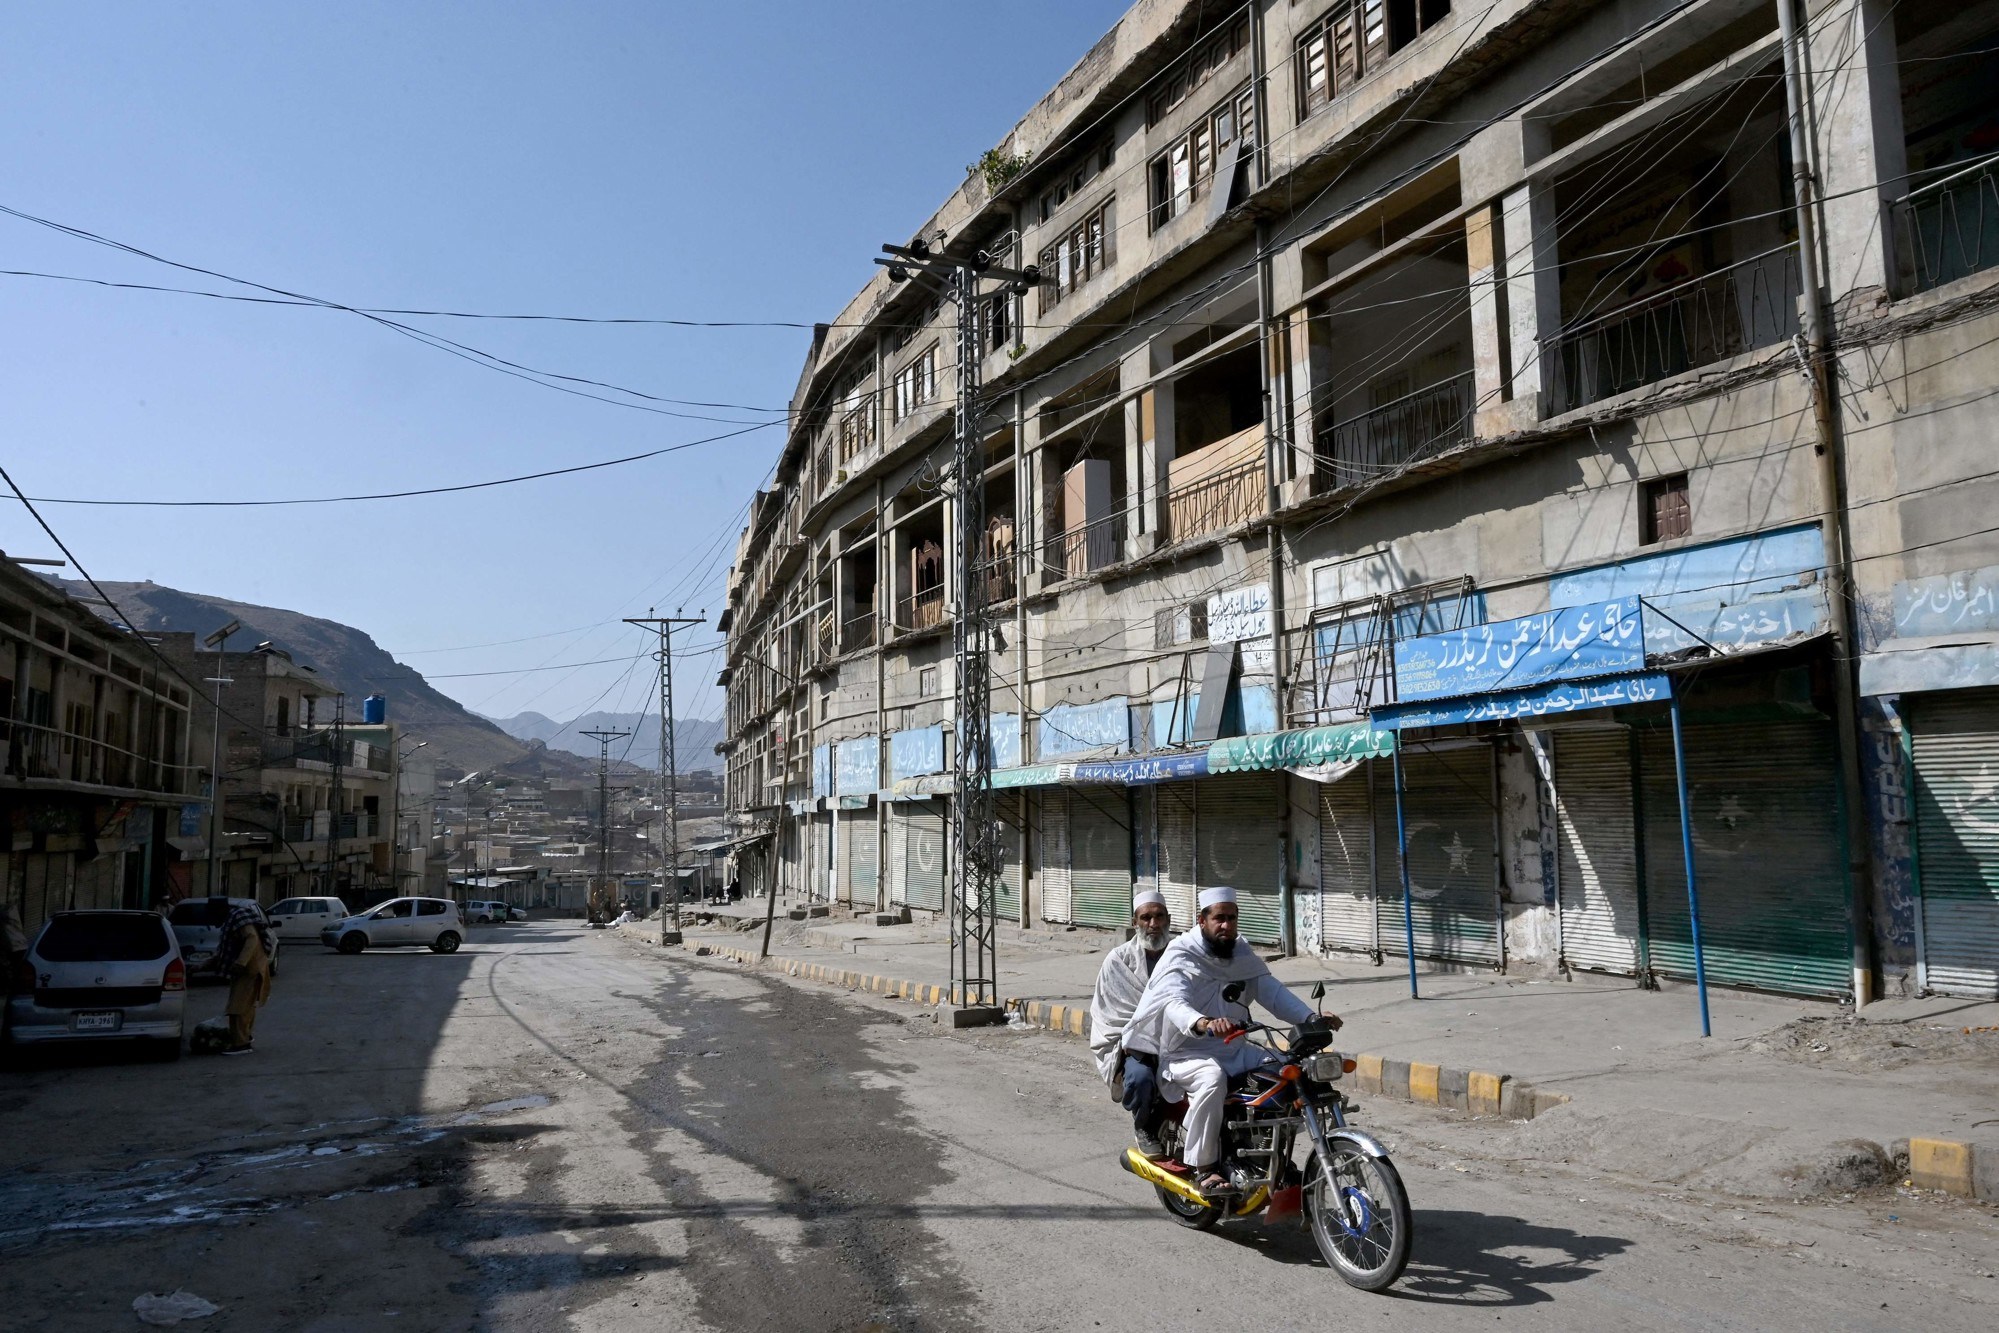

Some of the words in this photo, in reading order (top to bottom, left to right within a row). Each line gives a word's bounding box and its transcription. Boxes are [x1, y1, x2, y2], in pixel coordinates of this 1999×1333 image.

[1930, 580, 1967, 614] خان
[1953, 585, 1994, 625] امیر
[1599, 603, 1637, 647] حاجی
[1733, 604, 1793, 647] اختر
[1437, 625, 1494, 671] ٹریڈرز
[1627, 679, 1656, 702] حاجی
